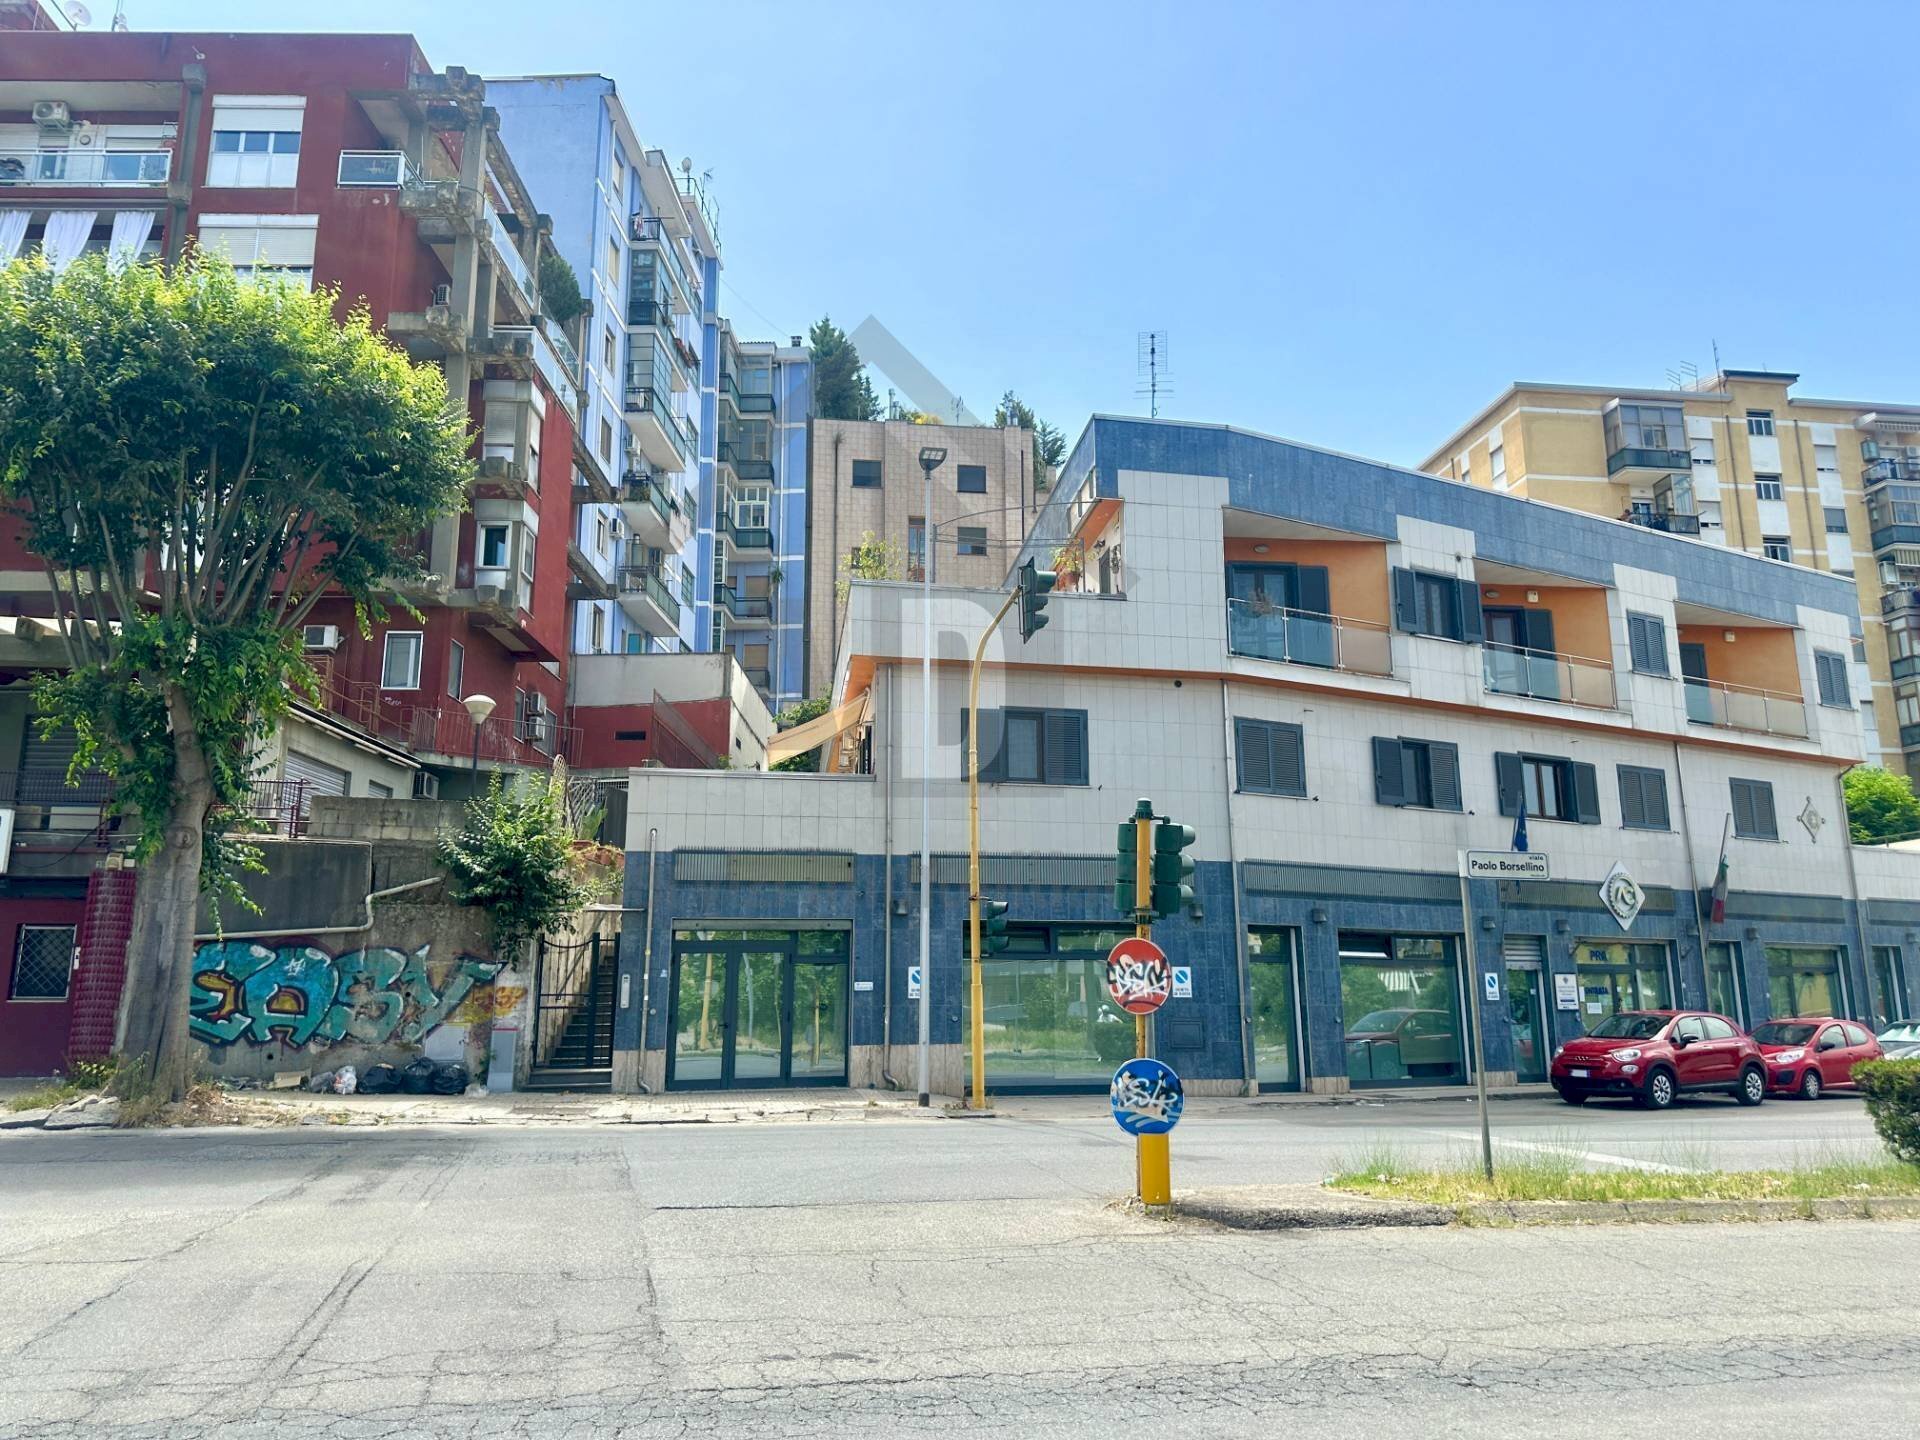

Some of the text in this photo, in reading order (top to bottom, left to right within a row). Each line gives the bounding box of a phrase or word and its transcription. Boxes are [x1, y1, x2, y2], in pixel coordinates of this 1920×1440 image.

[1471, 860, 1545, 872] Paolo Borsellino
[1590, 949, 1608, 961] PRA
